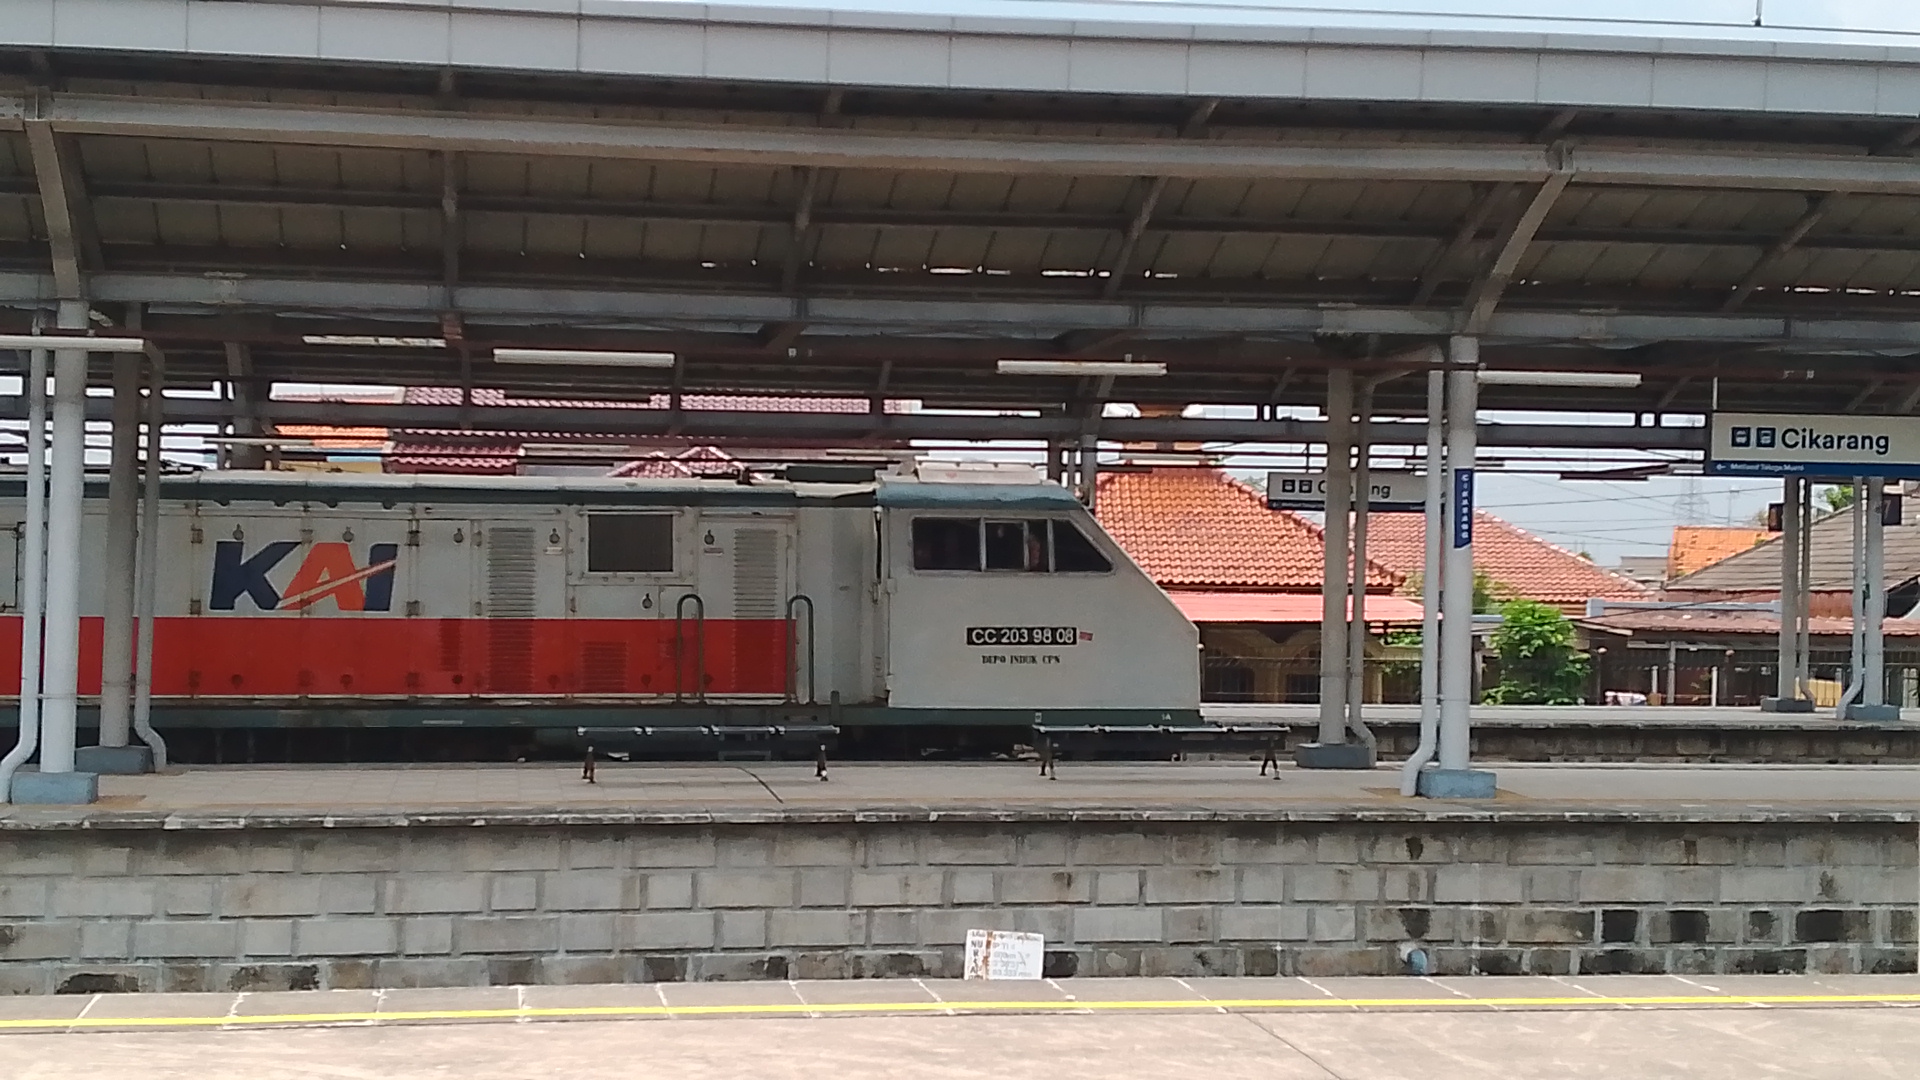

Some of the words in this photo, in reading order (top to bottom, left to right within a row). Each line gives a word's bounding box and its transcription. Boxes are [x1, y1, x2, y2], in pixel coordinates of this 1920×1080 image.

[1780, 427, 1890, 456] Cikarang
[209, 540, 399, 612] KAI
[972, 629, 997, 643] CC
[1000, 629, 1028, 643] 203
[1033, 629, 1052, 643] 98
[1056, 629, 1074, 644] 08
[982, 655, 1006, 665] DEPO
[1010, 655, 1038, 665] INDUK
